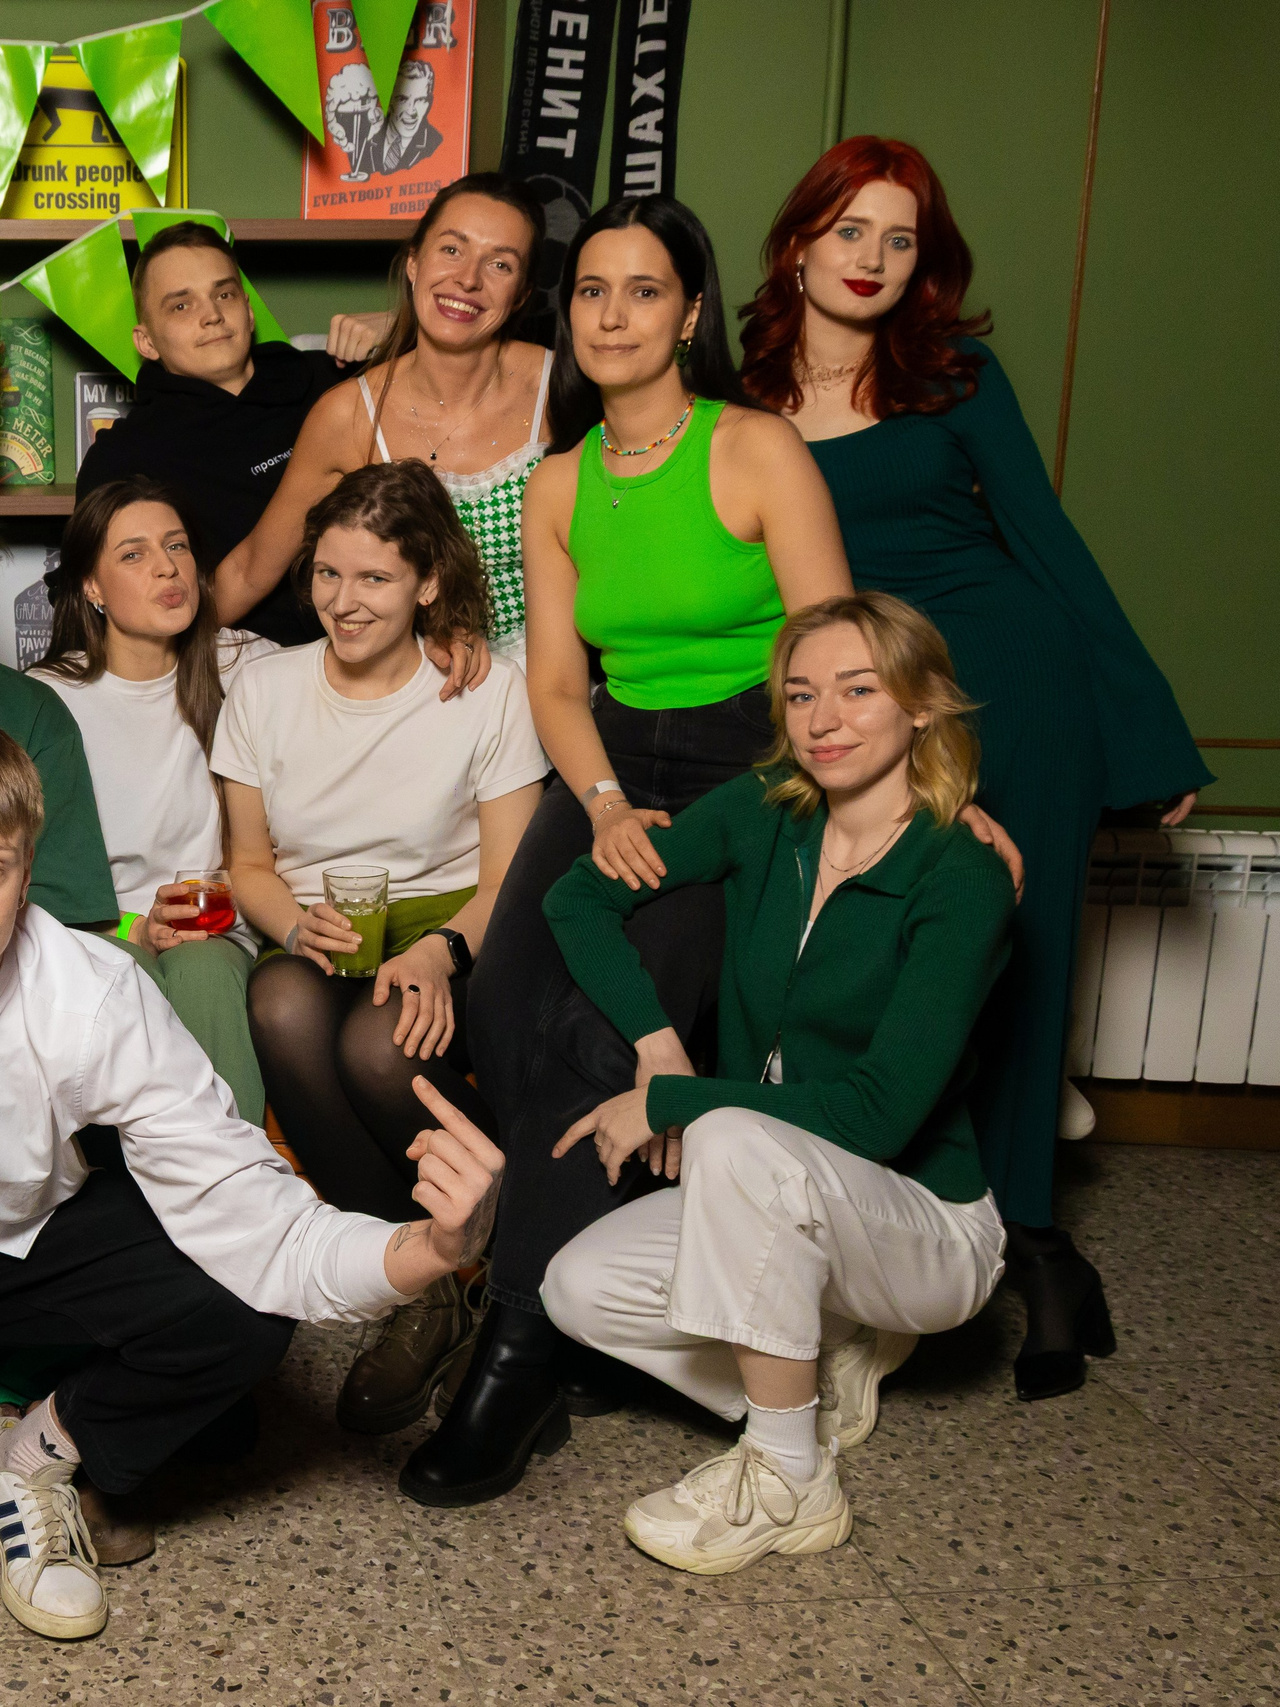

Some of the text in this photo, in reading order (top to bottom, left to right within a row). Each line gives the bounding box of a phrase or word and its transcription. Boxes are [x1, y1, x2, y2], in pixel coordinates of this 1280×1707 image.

[325, 3, 457, 53] BR
[536, 0, 590, 158] ЕНИТ
[75, 160, 145, 187] people
[34, 187, 120, 214] crossing
[313, 186, 393, 207] EVERYBODY
[399, 180, 441, 197] NEEDS
[83, 384, 108, 403] MY
